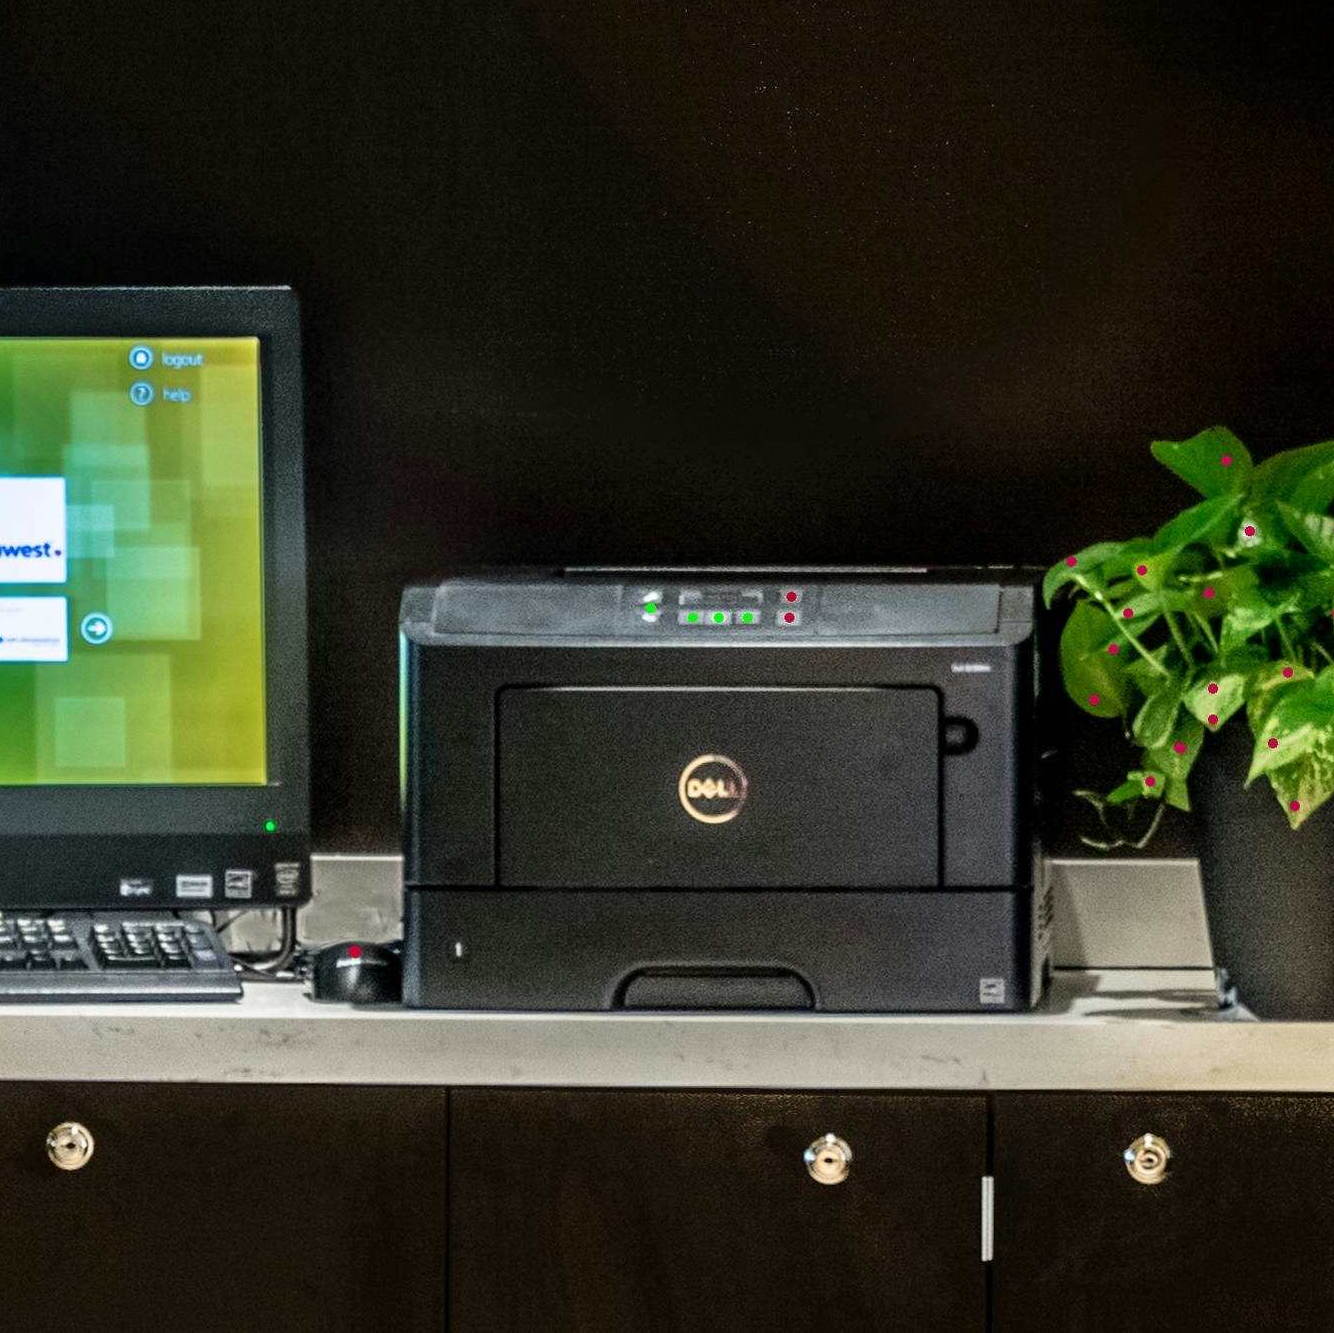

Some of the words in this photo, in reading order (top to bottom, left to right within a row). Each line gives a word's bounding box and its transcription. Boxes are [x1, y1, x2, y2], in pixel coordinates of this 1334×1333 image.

[161, 353, 204, 369] logout
[162, 387, 192, 403] help
[687, 778, 739, 799] DELL
